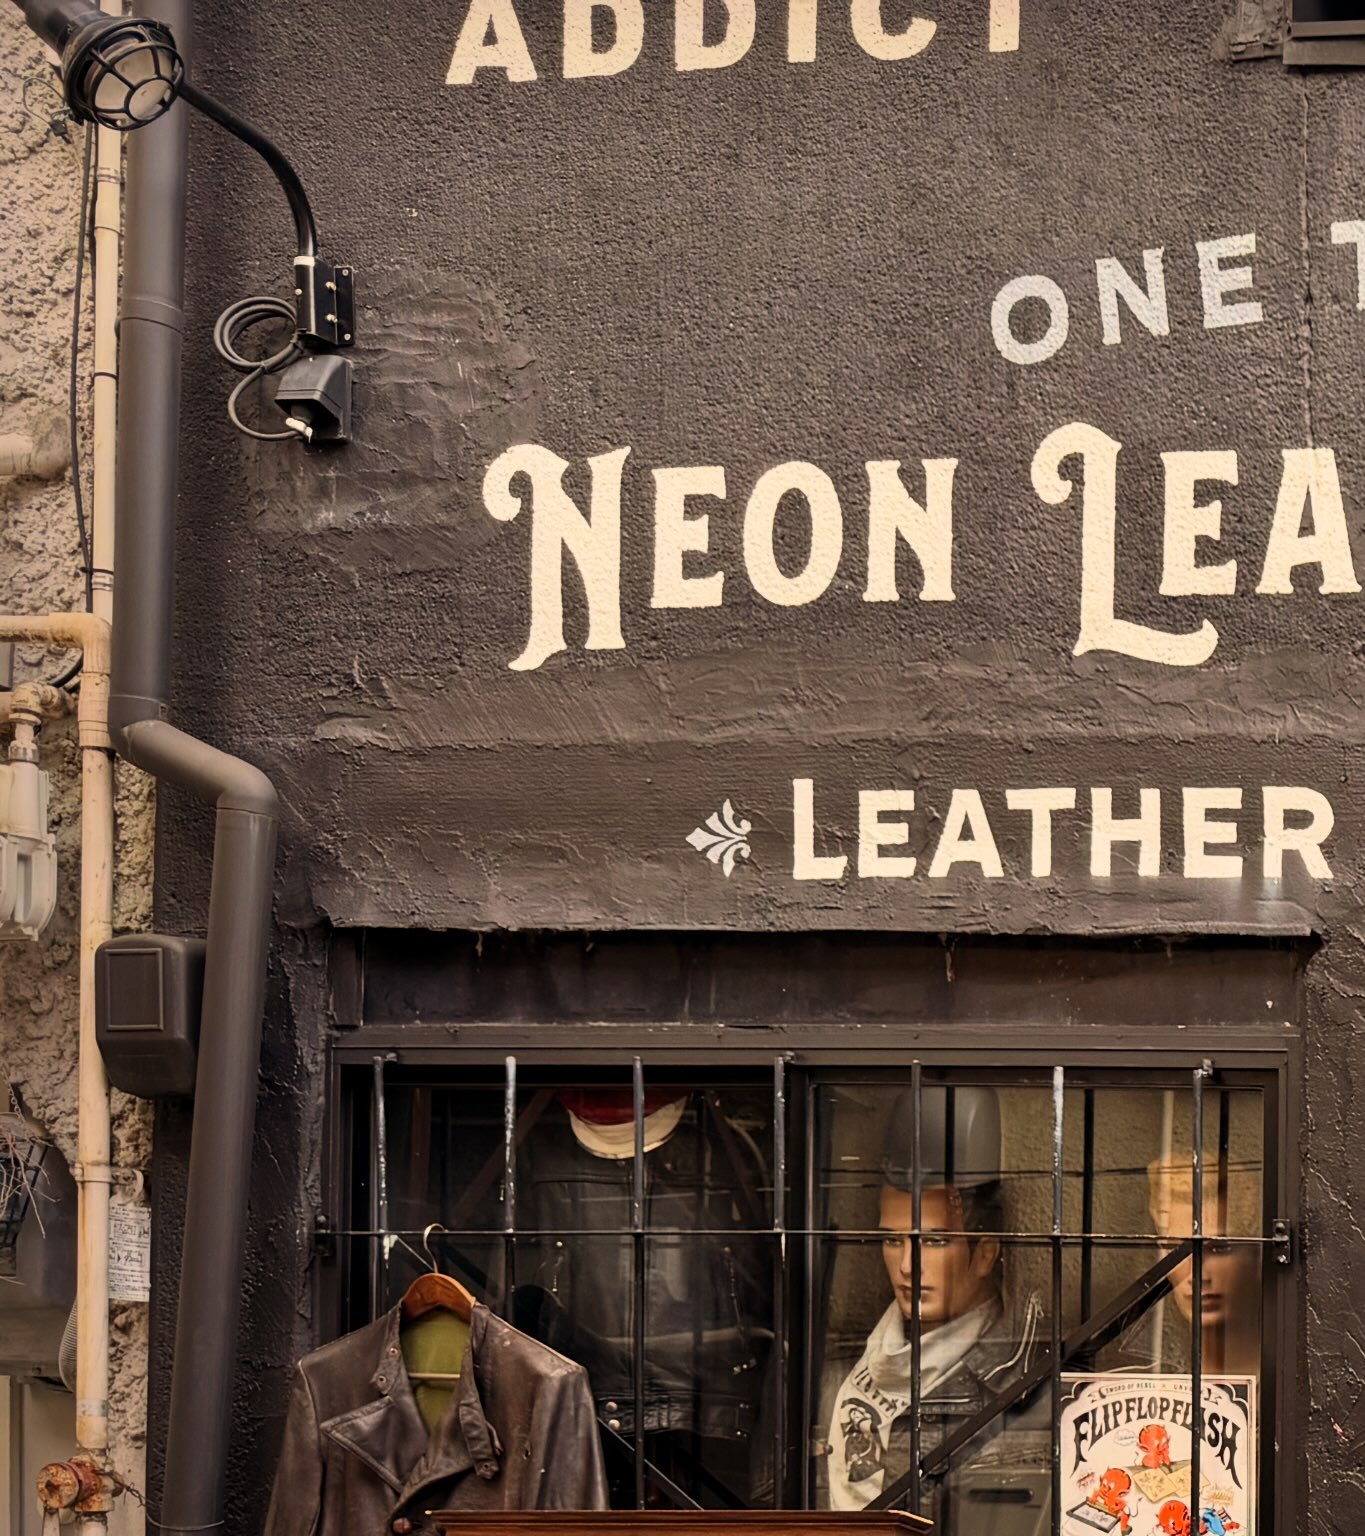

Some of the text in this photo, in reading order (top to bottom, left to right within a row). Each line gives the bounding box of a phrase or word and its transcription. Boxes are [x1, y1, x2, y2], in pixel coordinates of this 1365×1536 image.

[991, 232, 1263, 365] ONE
[483, 444, 957, 670] NEON
[793, 778, 1335, 881] LEATHER
